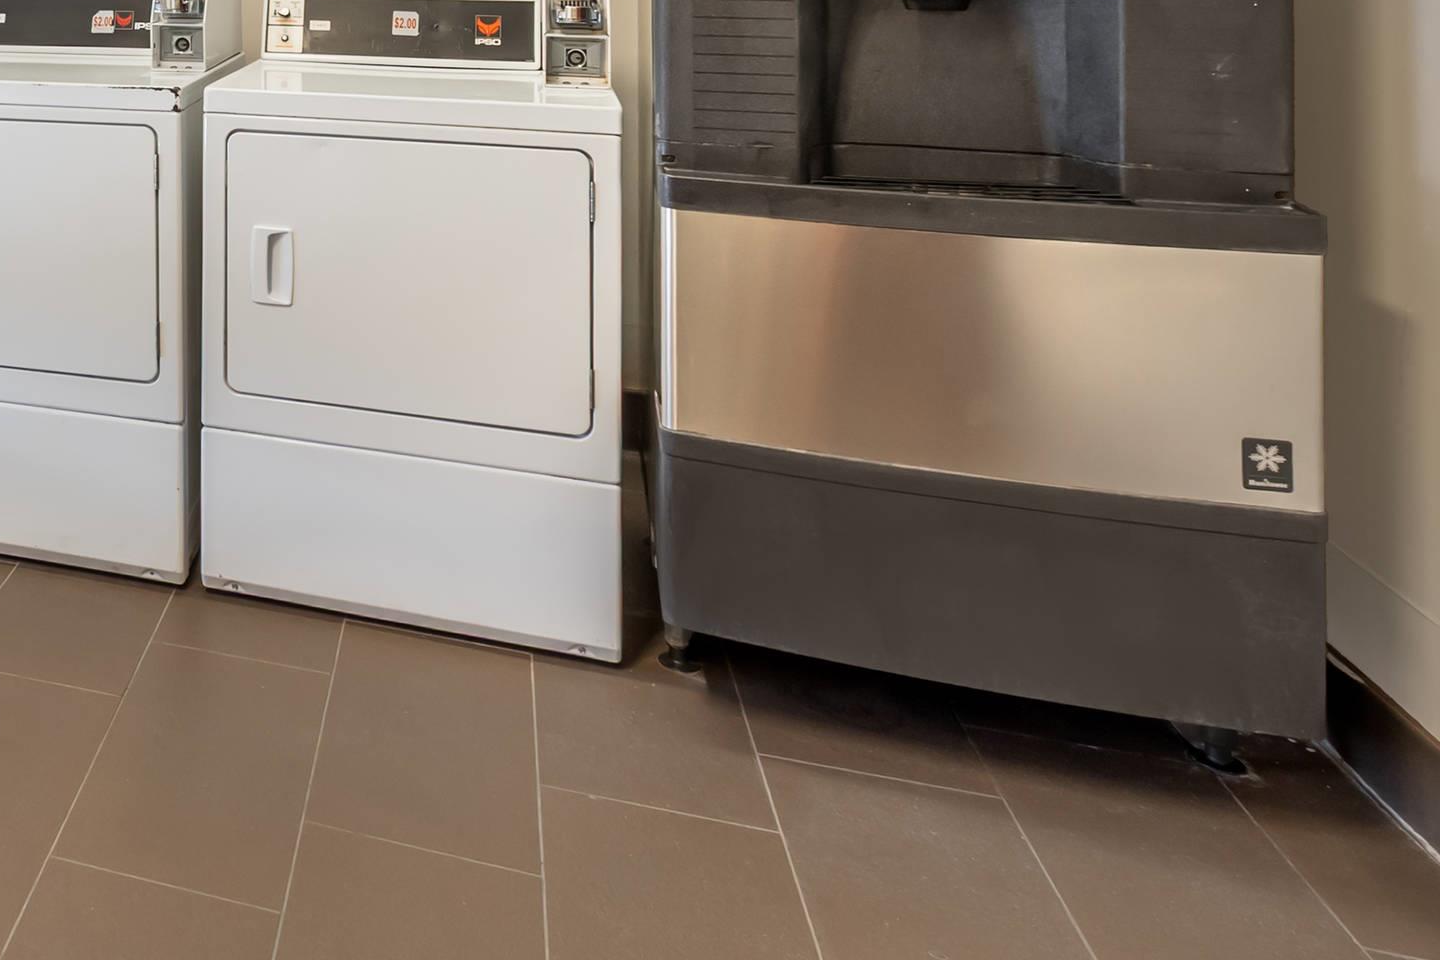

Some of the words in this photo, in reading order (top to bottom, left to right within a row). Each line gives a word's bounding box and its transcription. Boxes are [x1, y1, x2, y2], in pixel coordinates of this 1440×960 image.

[94, 16, 114, 26] $2.00
[394, 16, 417, 30] $2.00
[134, 22, 152, 30] IPS
[474, 38, 502, 46] IPSO
